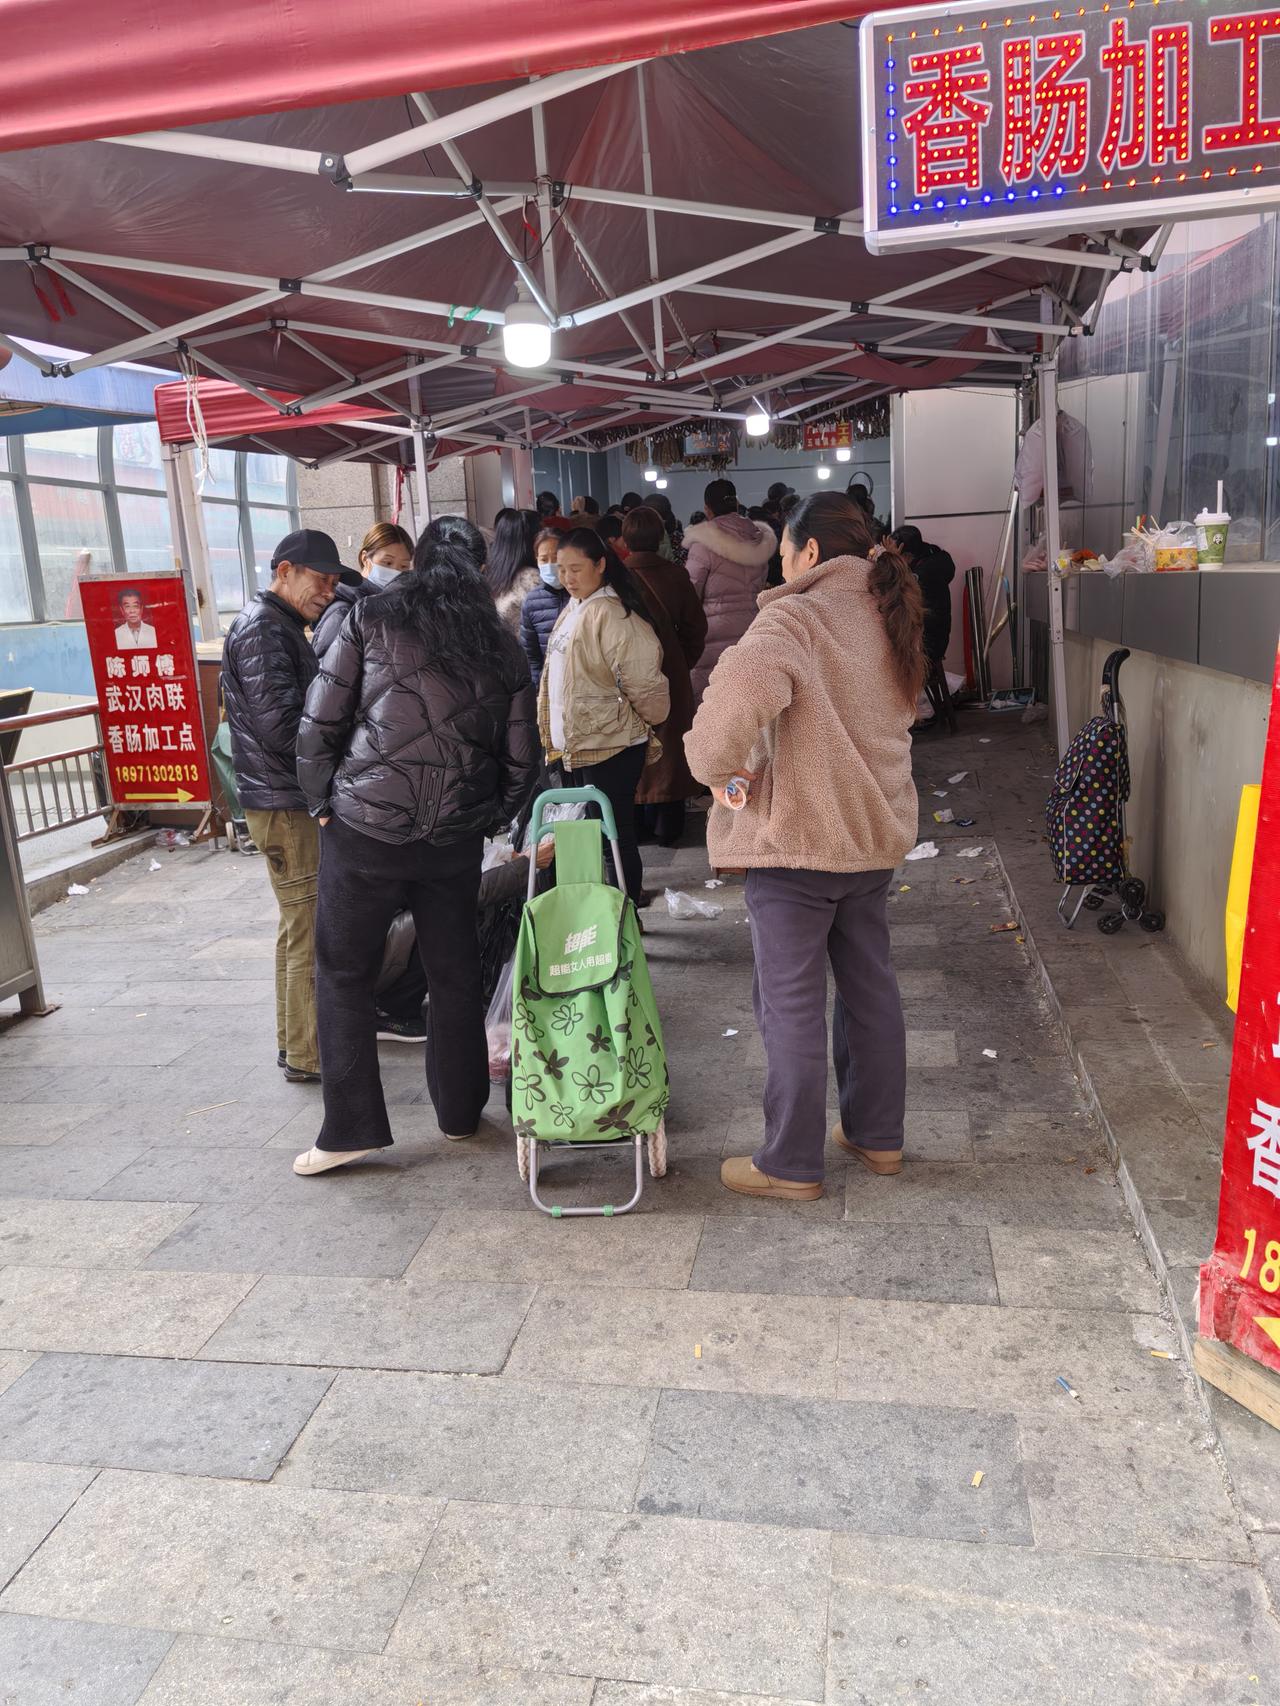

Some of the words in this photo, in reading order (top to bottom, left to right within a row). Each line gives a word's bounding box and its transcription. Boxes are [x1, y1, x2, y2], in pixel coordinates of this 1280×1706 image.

[902, 12, 1280, 195] 香肠加工
[105, 654, 175, 678] 陈师傅
[105, 684, 186, 712] 武汉肉联
[108, 722, 196, 753] 香肠加工点
[116, 765, 198, 782] 18971302813
